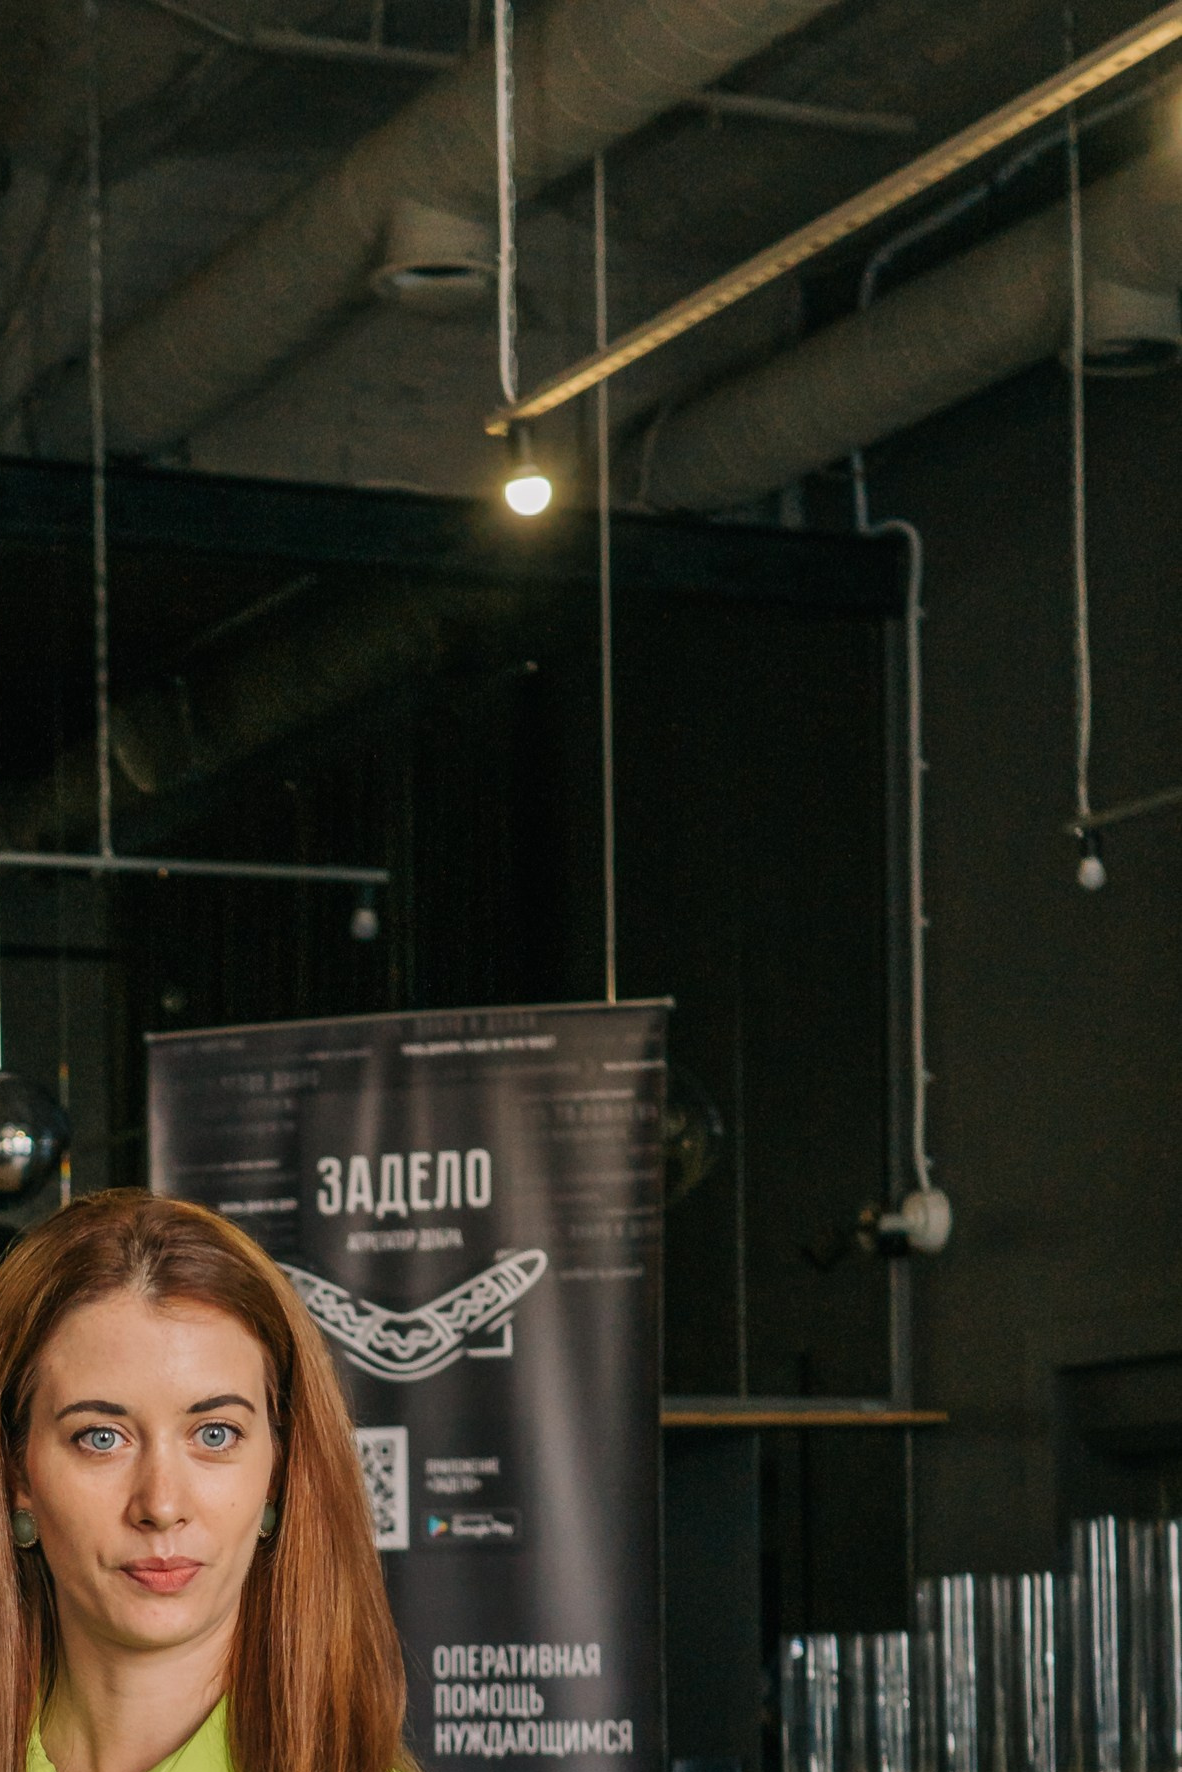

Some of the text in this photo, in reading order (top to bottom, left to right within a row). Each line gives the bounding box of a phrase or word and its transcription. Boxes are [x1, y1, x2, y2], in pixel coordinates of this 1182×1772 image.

[316, 1148, 492, 1220] ЗАДЕЛО
[433, 1643, 602, 1680] ОПЕРАТИВНАЯ
[434, 1682, 546, 1719] ПОМОЩЬ
[434, 1719, 634, 1758] НУЖДАЮЩИМСЯ
